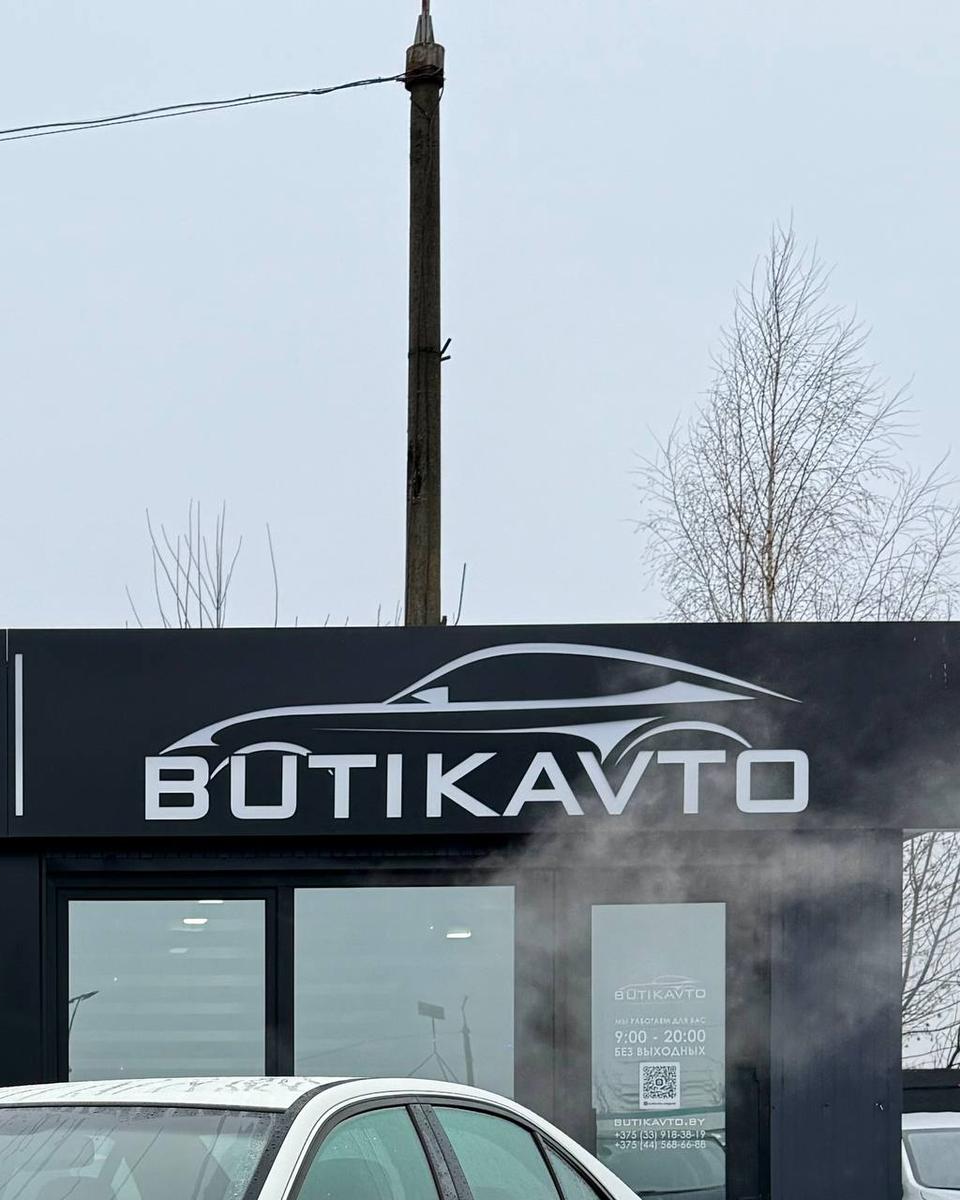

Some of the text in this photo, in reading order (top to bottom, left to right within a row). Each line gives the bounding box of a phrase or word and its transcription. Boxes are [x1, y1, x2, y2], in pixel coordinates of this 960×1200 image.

[144, 748, 810, 821] BUTIKAVTO
[614, 988, 707, 1001] BUTIKAVTO
[615, 1030, 647, 1044] 9:00
[664, 1029, 706, 1043] 20:00
[614, 1046, 706, 1057] БЕЗ ВЫХОДНЫХ
[614, 1118, 705, 1126] BUTIKAVTO.BY
[615, 1130, 706, 1141] +375 (33) 918-38-19
[615, 1140, 706, 1151] +375 (44) 568-66-88
